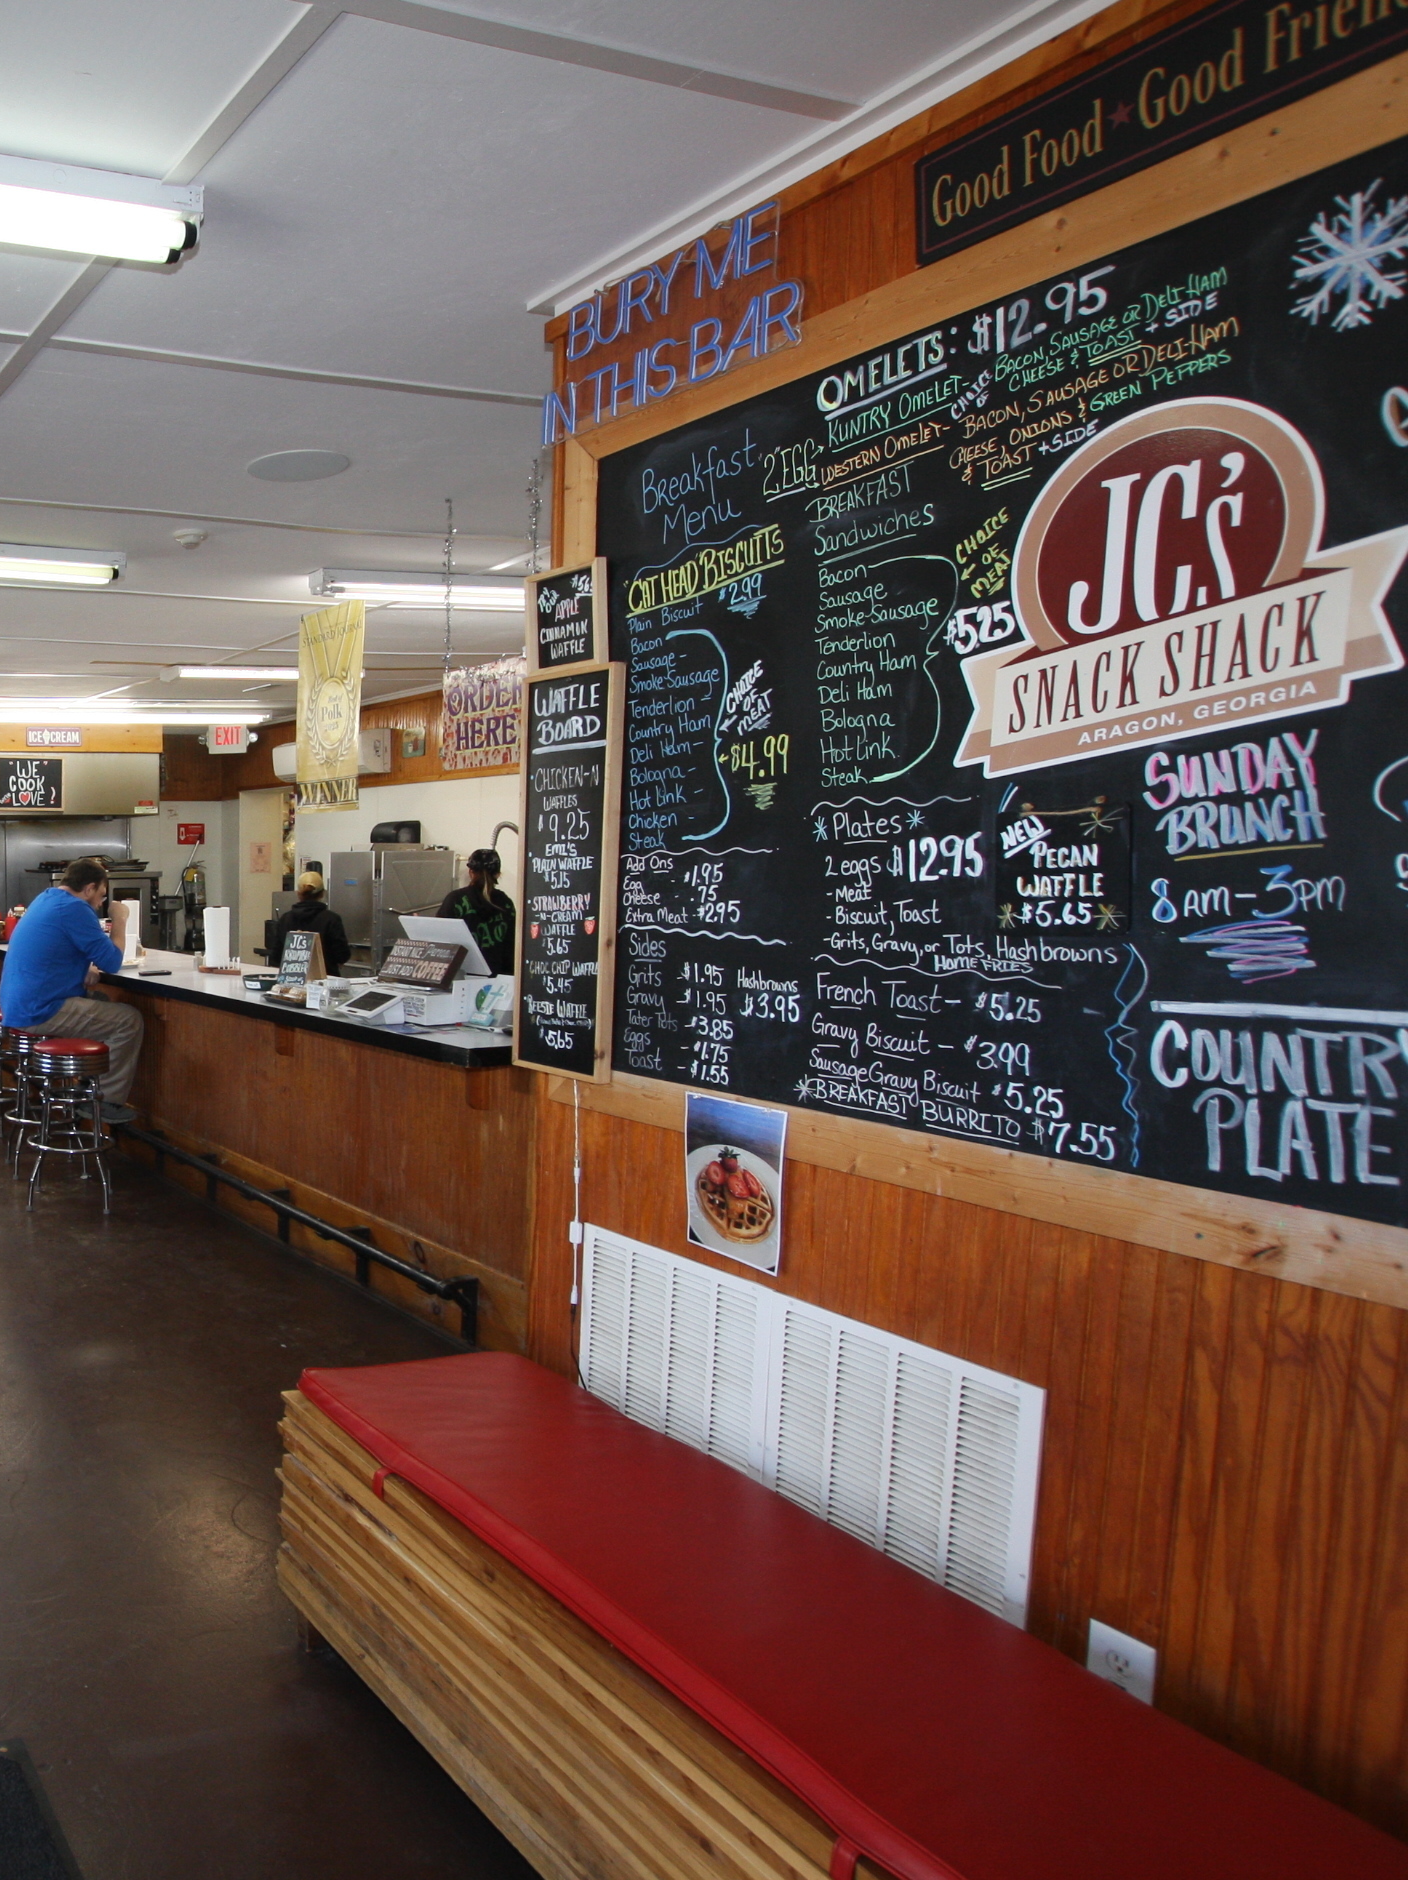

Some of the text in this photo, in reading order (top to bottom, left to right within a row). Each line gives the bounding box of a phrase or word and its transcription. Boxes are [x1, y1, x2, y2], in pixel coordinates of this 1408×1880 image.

[931, 145, 1011, 227] Good
[1022, 99, 1103, 188] Food
[1138, 27, 1245, 130] Good
[568, 201, 776, 361] BURY ME
[968, 265, 1116, 354] $12.95
[1009, 292, 1219, 392] CHEESE TOAST SIDE
[542, 282, 801, 445] IN THIS BAR
[828, 402, 891, 447] KUNTRY
[1049, 315, 1116, 355] SAUSAGE
[1122, 304, 1141, 323] OR
[1027, 369, 1110, 413] SAUSAGE
[1113, 354, 1140, 379] OR
[1009, 380, 1142, 444] ONIONS GREEN
[976, 442, 1038, 479] TOAST
[805, 461, 914, 523] BREAKFAST
[663, 499, 742, 544] Menu
[818, 564, 867, 588] Bacon
[555, 597, 579, 622] APPLE
[819, 583, 887, 614] Sausage
[627, 596, 704, 634] Plain Biscuit
[550, 638, 585, 660] WAFFLE
[630, 637, 663, 655] Bacon
[631, 652, 677, 676] Sausage
[817, 650, 917, 688] Country Ham
[1007, 591, 1328, 736] SNACK SHACK
[629, 674, 665, 693] Smoke
[818, 677, 893, 704] Deli Ham
[534, 683, 600, 717] WAFFLE
[1077, 681, 1317, 746] ARAGON, GEORGIA
[29, 731, 80, 743] ICE CREAM
[215, 726, 242, 745] EXIT
[456, 713, 517, 750] HERE
[537, 714, 601, 745] BOARD
[629, 713, 711, 745] Country Ham
[820, 707, 896, 744] Bologna
[630, 745, 654, 765] Deli
[820, 735, 853, 764] Hot
[9, 775, 45, 792] COOK
[629, 765, 685, 791] Bologna
[1143, 728, 1328, 811] SUNDAY
[299, 778, 358, 805] WINNER
[630, 791, 651, 811] Hot
[628, 812, 678, 829] Chicken
[832, 810, 903, 840] Plates
[1000, 815, 1045, 850] NEW
[1156, 788, 1327, 856] BRUNCH
[628, 830, 666, 851] Steak
[1029, 840, 1099, 869] PECAN
[532, 856, 594, 873] PLAIN WAFFLE
[532, 892, 591, 911] STRAWBERRY
[623, 892, 661, 906] Cheese
[893, 898, 942, 925] Toast
[541, 924, 576, 937] WAFFLE
[625, 907, 689, 925] Extra Meat
[629, 932, 667, 958] Sides
[412, 960, 450, 980] COFFEE
[628, 964, 662, 987] Grits
[983, 958, 1034, 974] FRIES
[626, 986, 664, 1014] Gravy
[816, 972, 877, 1006] French
[881, 981, 942, 1014] Toast
[626, 1009, 652, 1028] Tater
[811, 1013, 930, 1058] Gravy Biscuit
[624, 1048, 663, 1071] Toast
[923, 1069, 981, 1103] Biscuit
[920, 1100, 1021, 1138] BURRITO
[1193, 1086, 1401, 1186] PLATE
